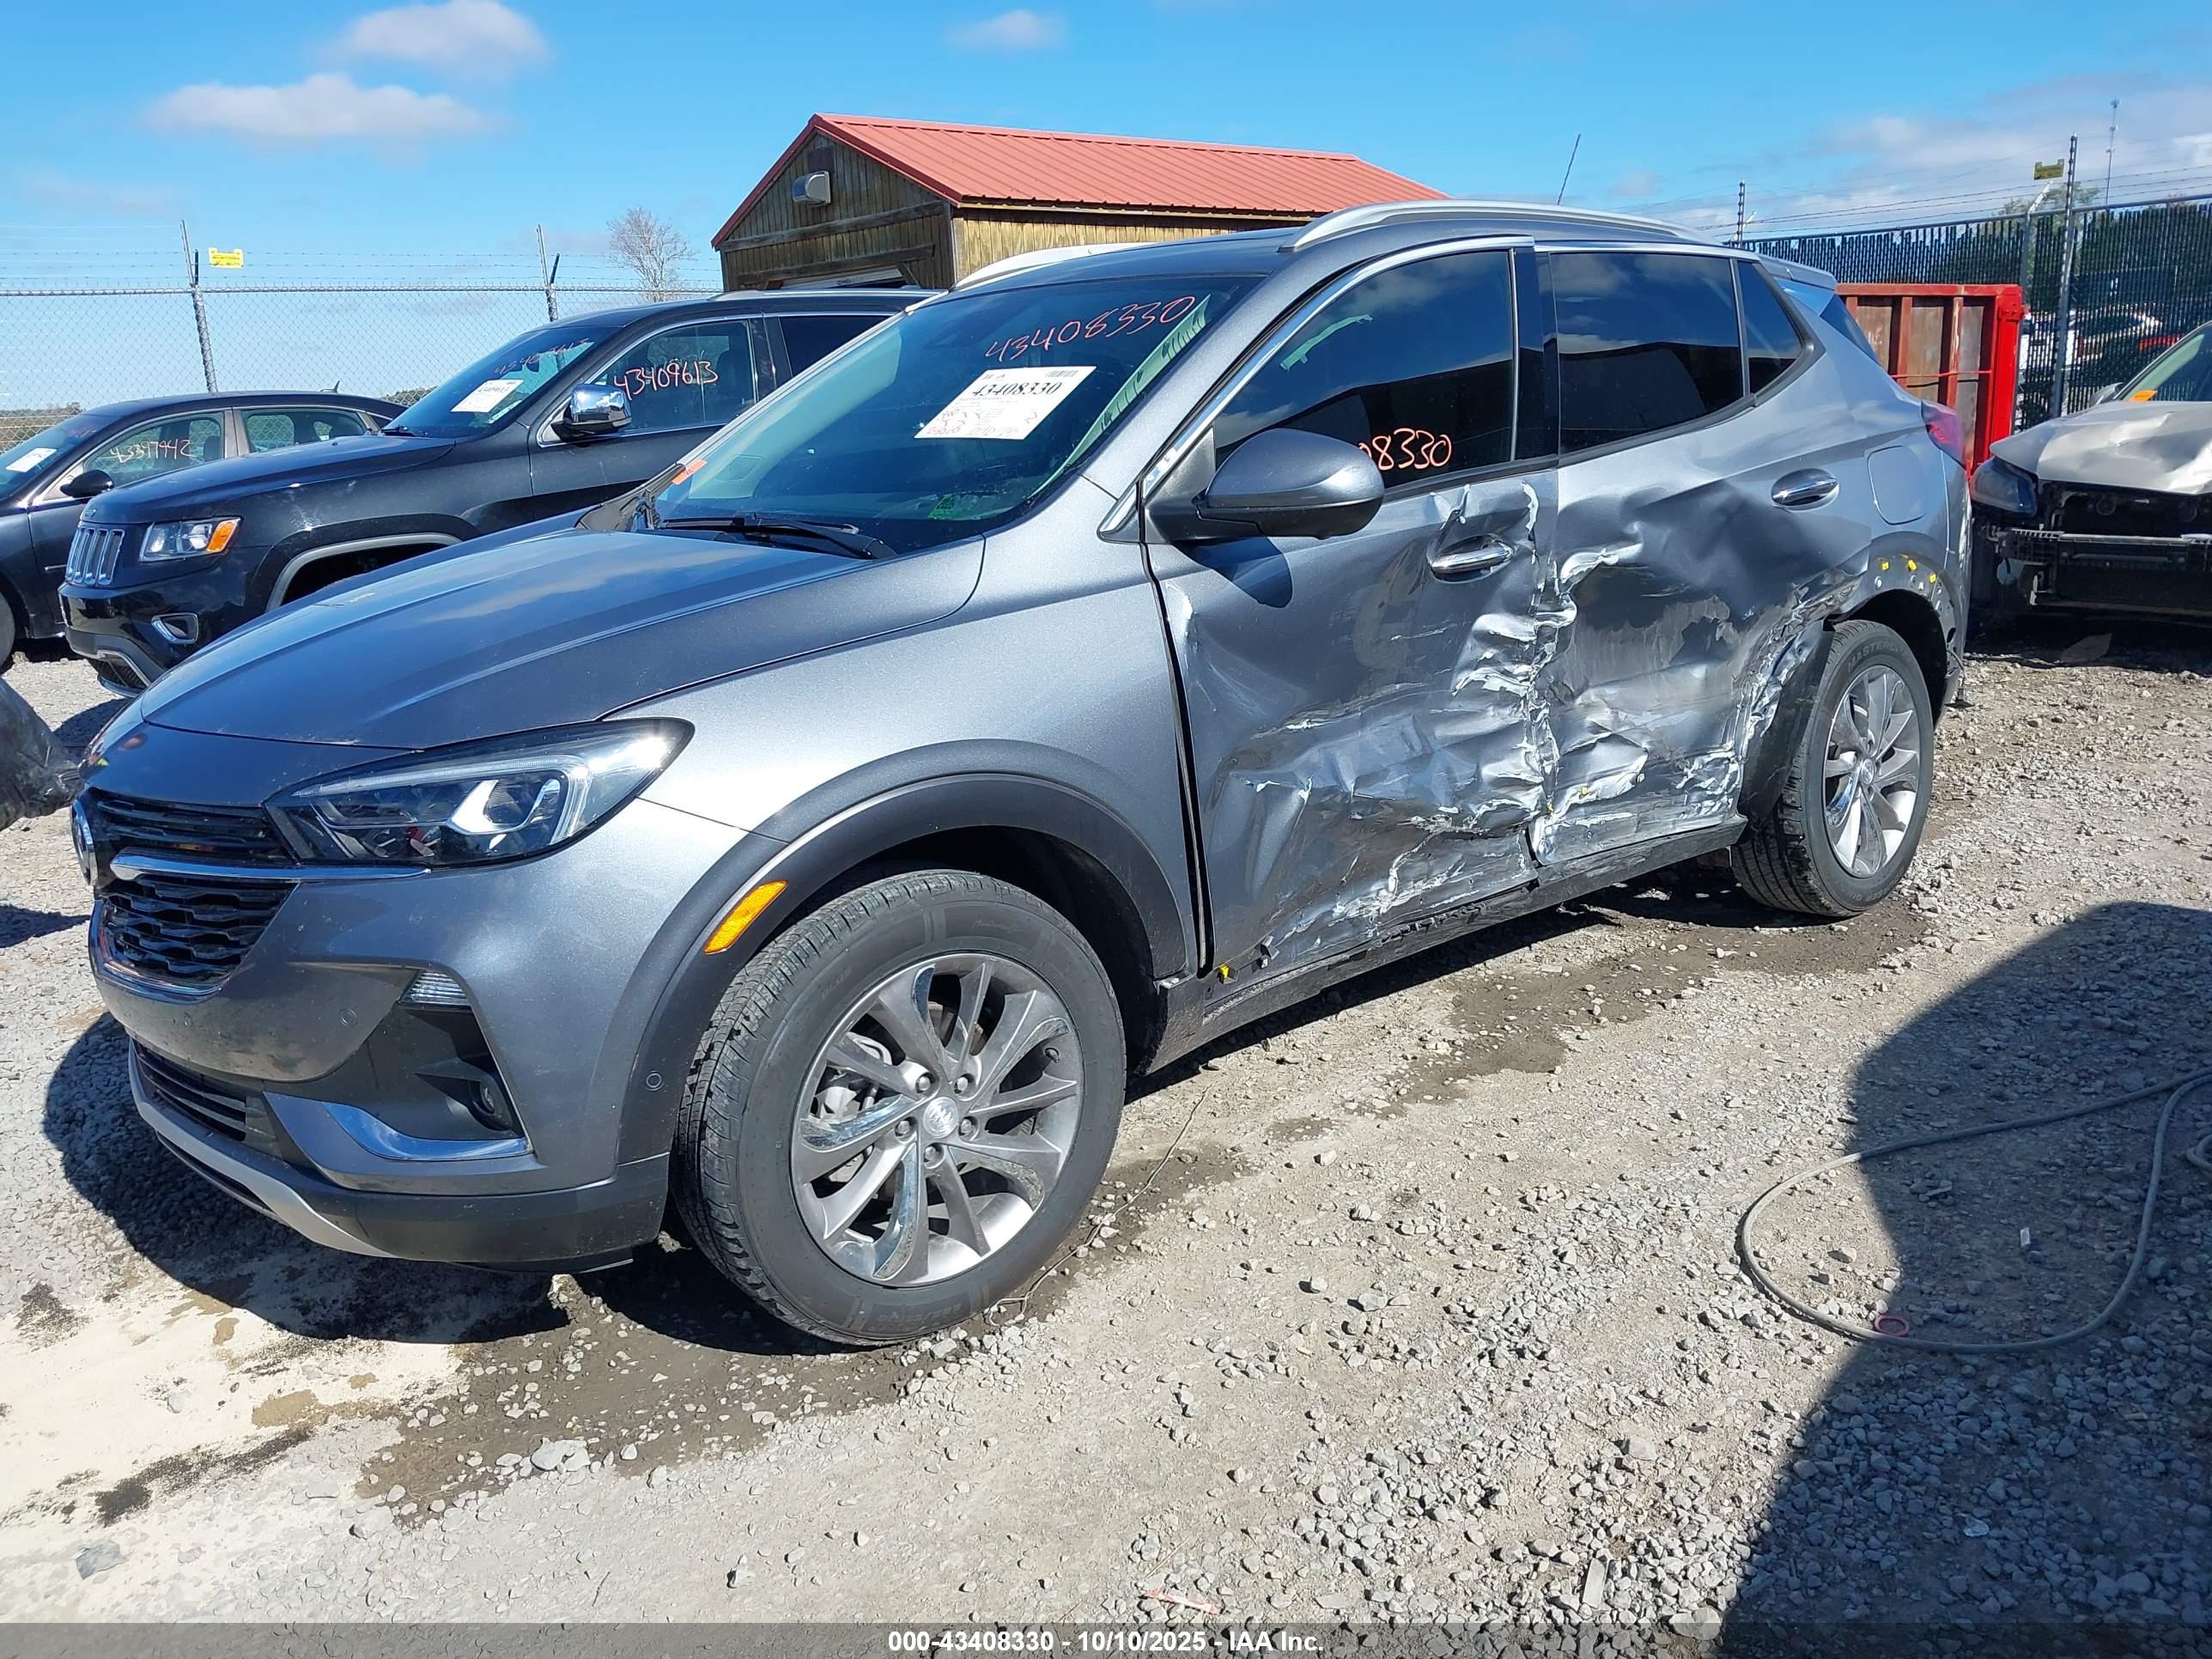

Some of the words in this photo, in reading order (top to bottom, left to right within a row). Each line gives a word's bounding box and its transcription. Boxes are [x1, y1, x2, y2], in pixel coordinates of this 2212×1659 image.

[985, 296, 1196, 362] 43408330
[613, 361, 719, 400] 43409613
[972, 381, 1063, 396] 43408330
